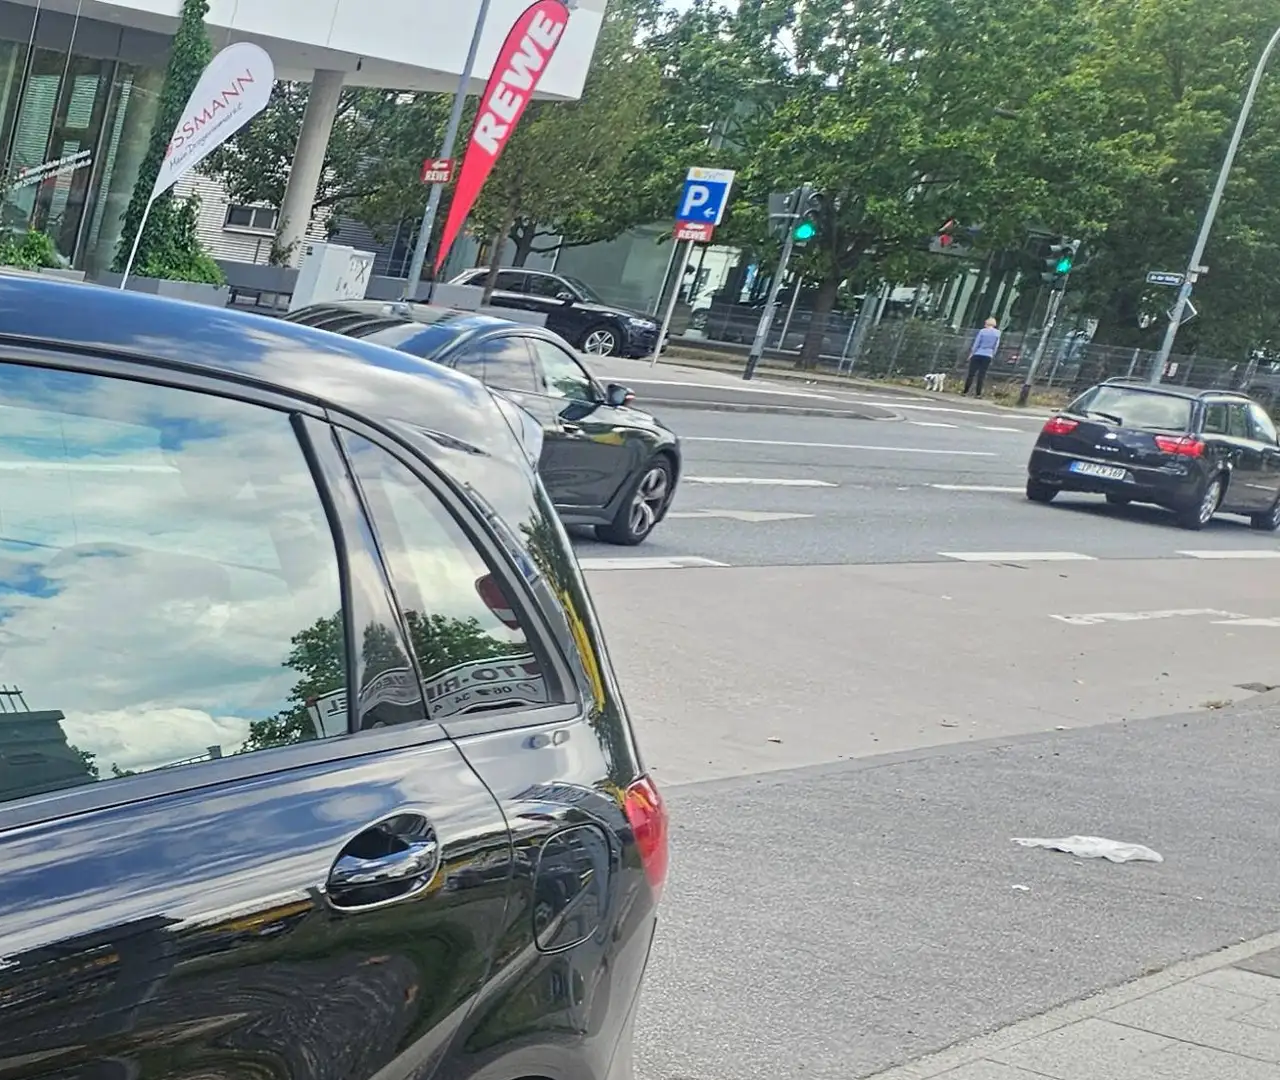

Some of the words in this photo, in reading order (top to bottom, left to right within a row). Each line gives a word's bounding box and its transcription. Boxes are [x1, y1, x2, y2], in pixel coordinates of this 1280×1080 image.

[473, 10, 564, 157] REWE
[424, 169, 449, 182] REWE
[680, 184, 710, 217] P
